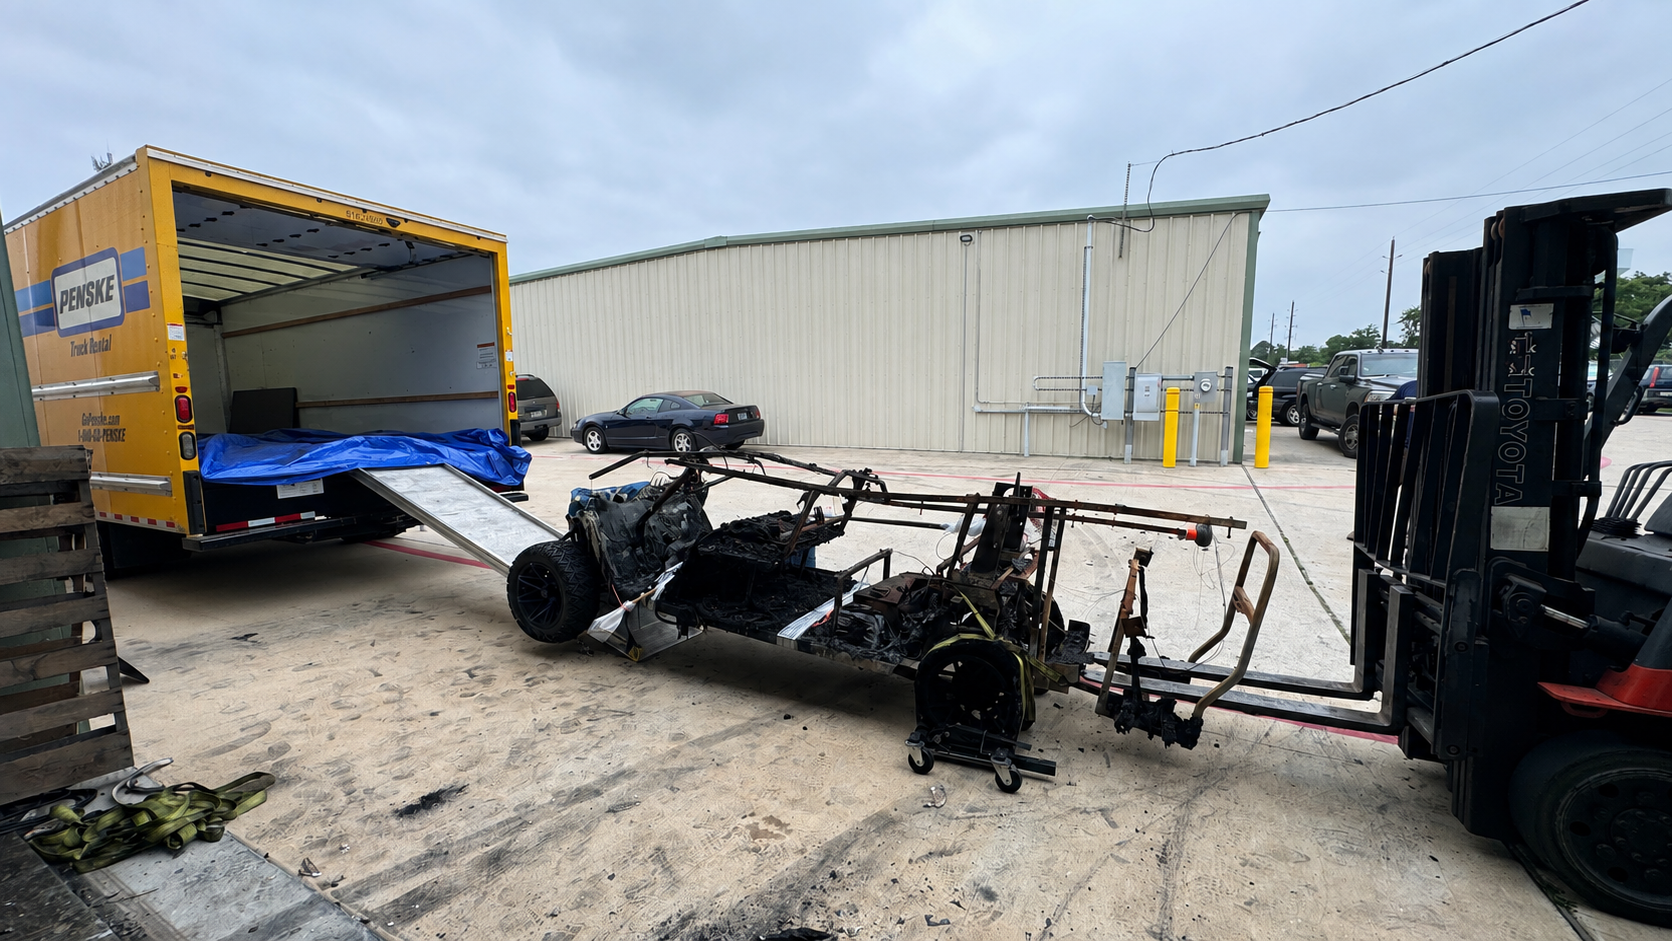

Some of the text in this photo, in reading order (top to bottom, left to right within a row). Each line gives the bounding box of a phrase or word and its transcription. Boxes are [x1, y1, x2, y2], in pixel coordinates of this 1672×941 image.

[59, 274, 115, 314] PENSKE
[70, 334, 112, 357] Truck Rental
[1494, 378, 1533, 506] TOYOTA
